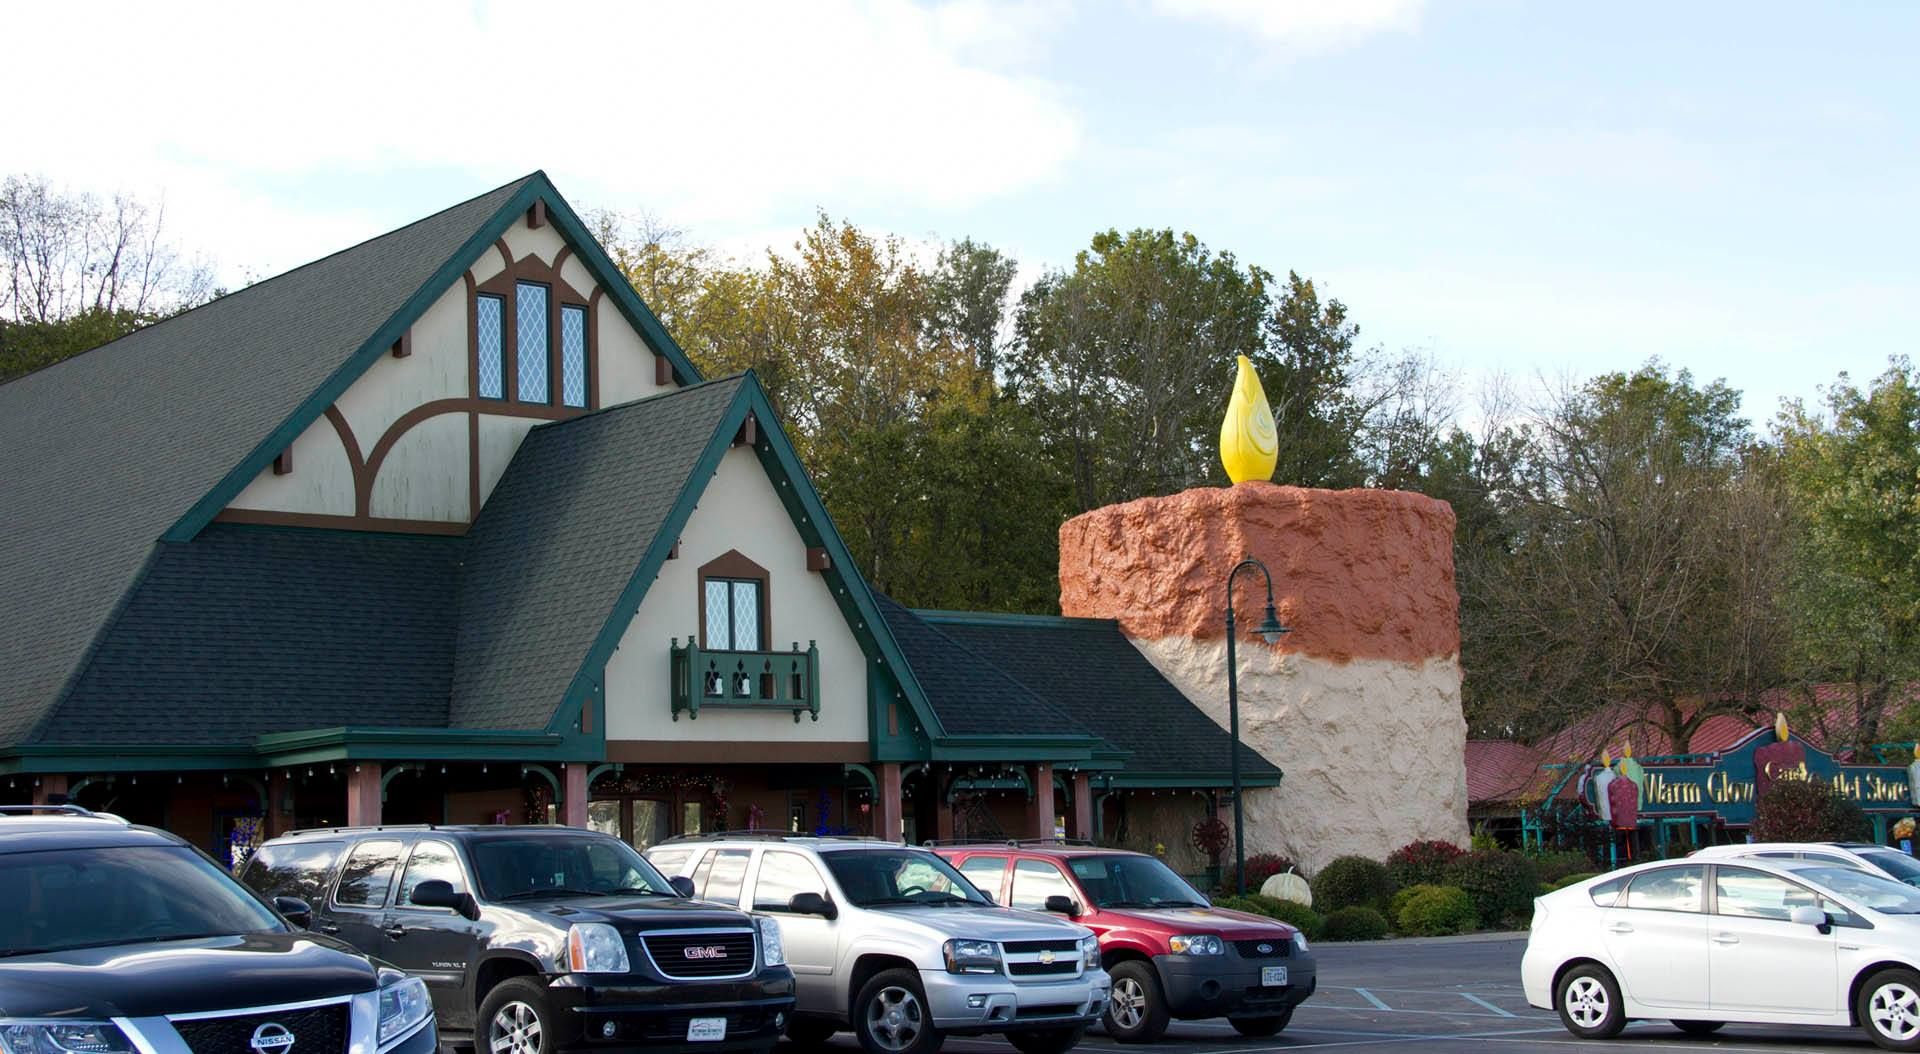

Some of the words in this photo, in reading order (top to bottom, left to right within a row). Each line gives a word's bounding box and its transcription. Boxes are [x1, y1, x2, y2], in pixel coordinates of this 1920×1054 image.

[1643, 773, 1700, 804] Warm
[1706, 771, 1754, 804] Glow
[1865, 772, 1909, 801] Store
[684, 945, 728, 959] GMC
[257, 1037, 292, 1045] NISSAN
